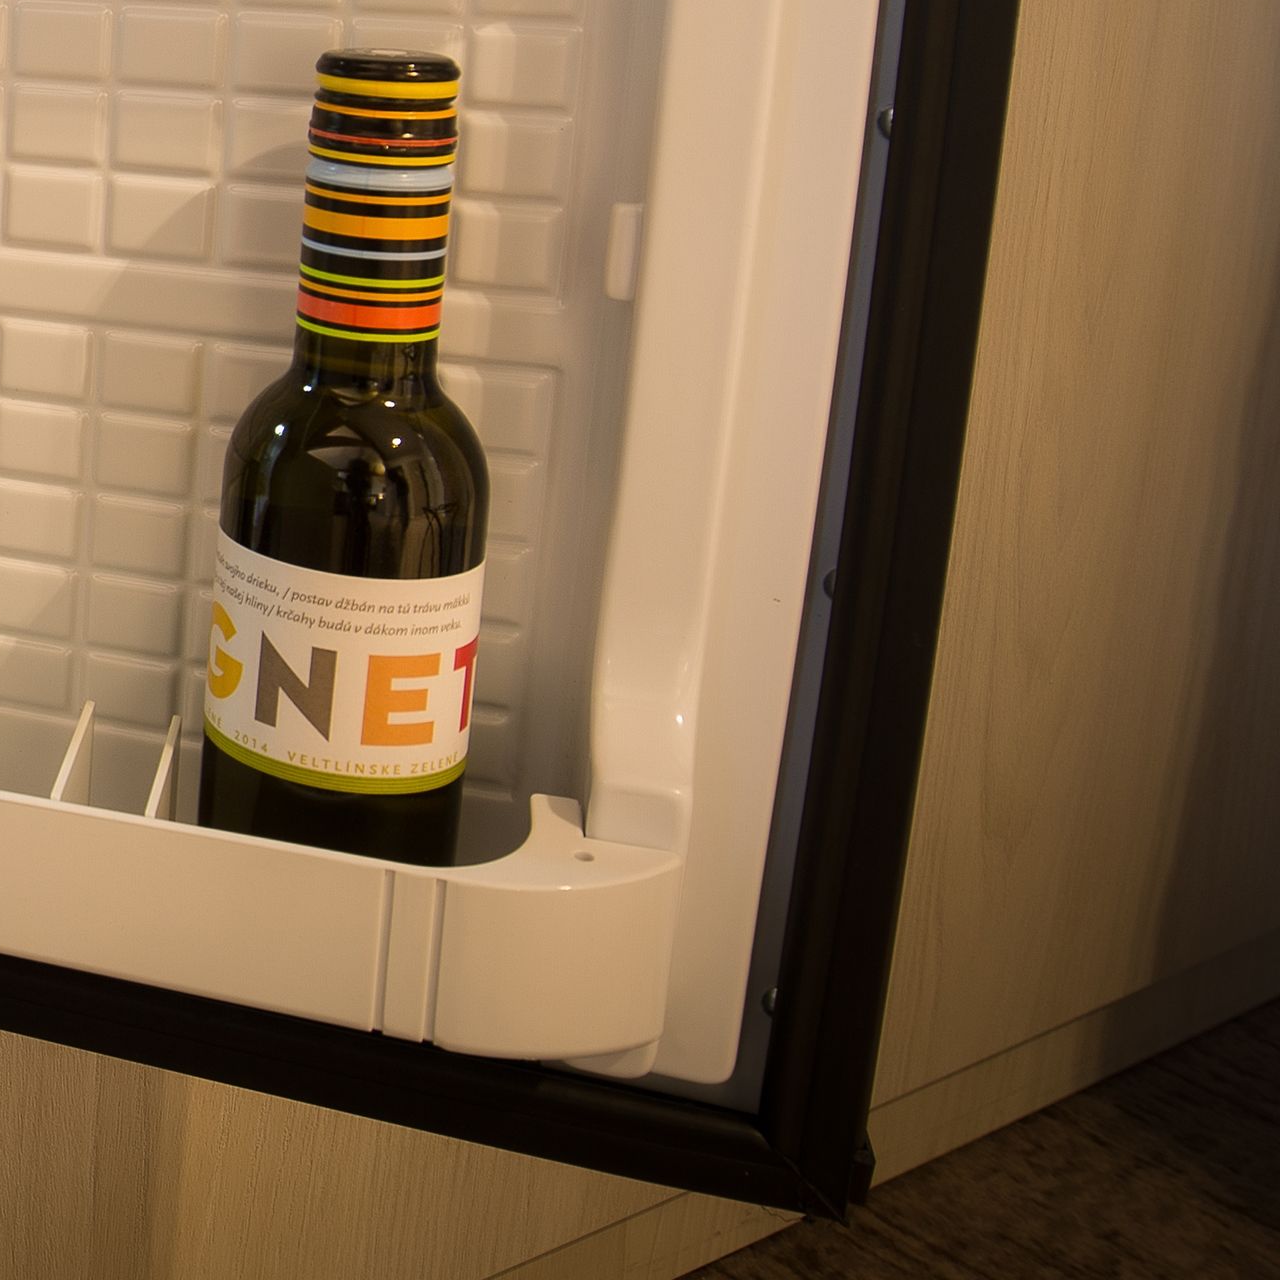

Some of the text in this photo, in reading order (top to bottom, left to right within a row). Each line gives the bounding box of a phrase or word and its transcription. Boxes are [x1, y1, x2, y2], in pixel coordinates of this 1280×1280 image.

[291, 590, 333, 608] postav
[334, 595, 376, 614] džbán
[378, 604, 395, 615] na
[397, 602, 411, 615] tú
[412, 600, 442, 615] trávu
[276, 607, 316, 630] krčahy
[318, 617, 352, 634] budú
[354, 624, 362, 634] v
[364, 619, 409, 637] dákom
[410, 623, 440, 637] inom
[233, 729, 269, 754] 2014
[287, 749, 402, 776] VELTLÍNSKE
